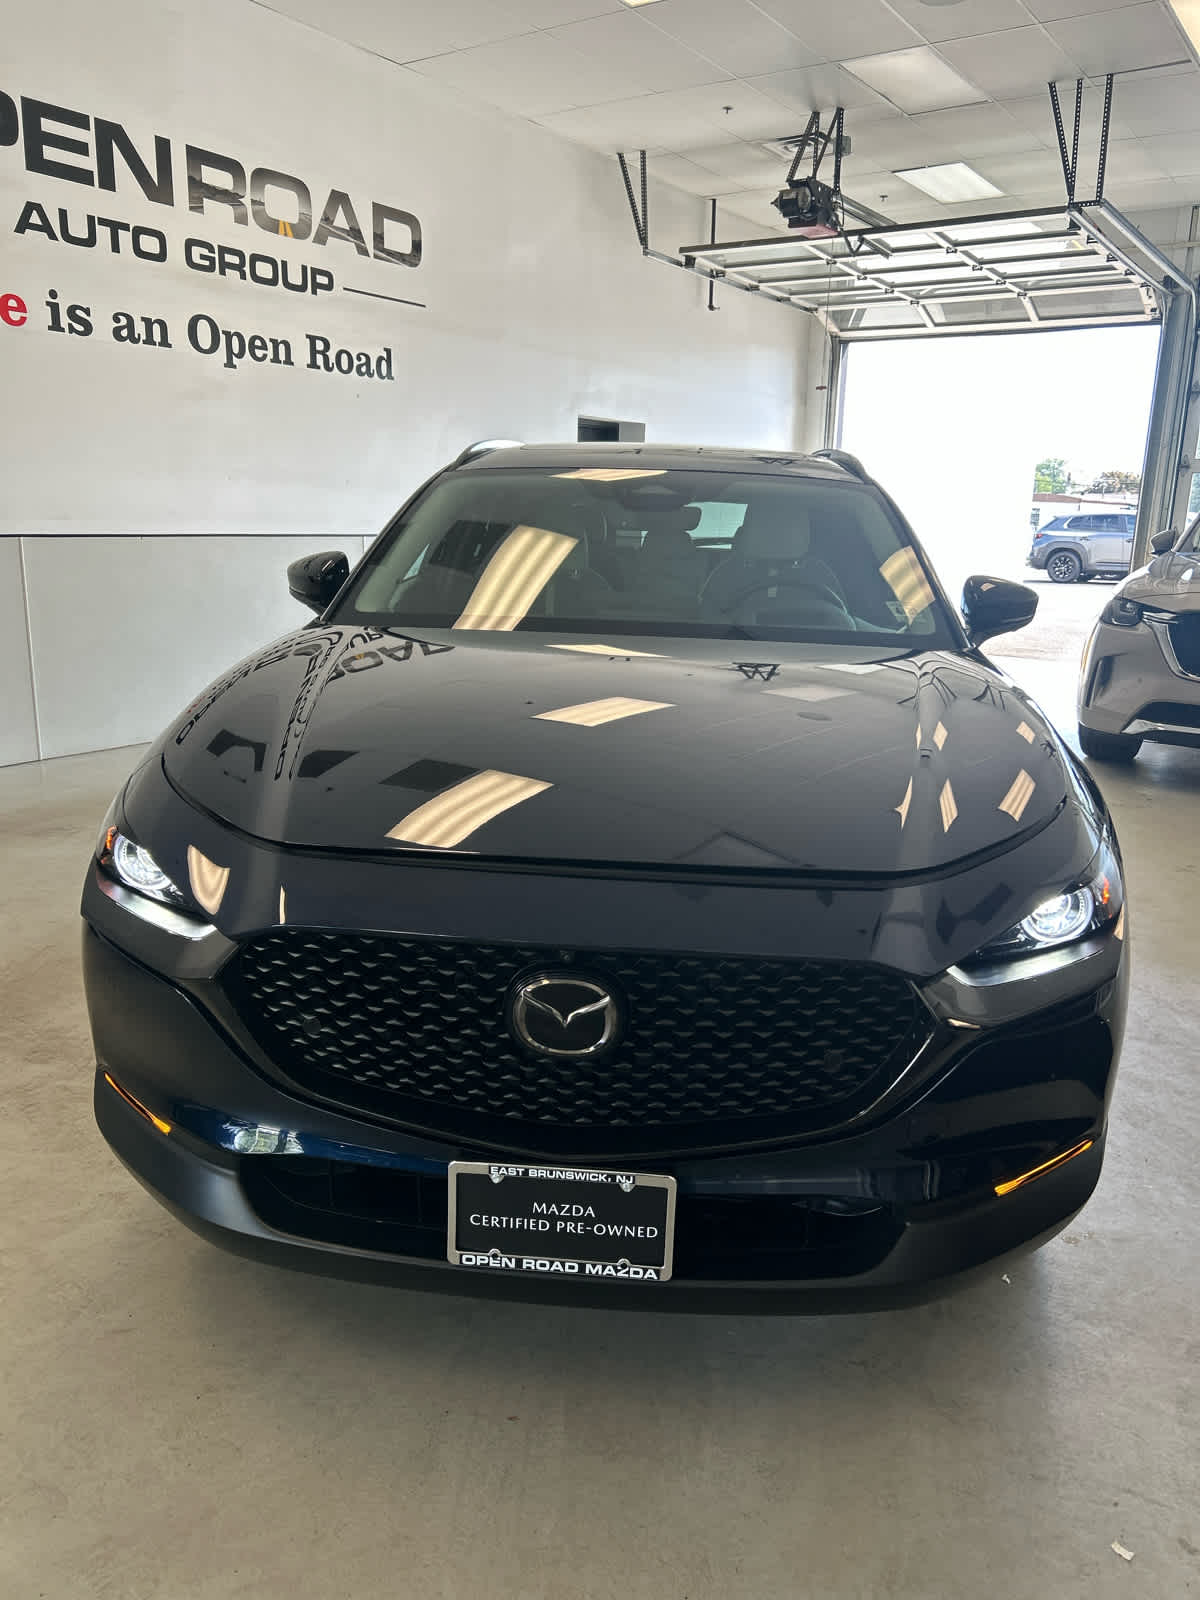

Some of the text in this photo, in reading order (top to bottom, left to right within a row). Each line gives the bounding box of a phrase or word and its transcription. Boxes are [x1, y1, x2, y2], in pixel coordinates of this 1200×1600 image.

[185, 144, 421, 268] ROAD
[13, 200, 334, 295] AUTO GROUP
[46, 288, 94, 337] is
[112, 309, 172, 349] an
[187, 314, 294, 369] Open
[305, 333, 395, 380] Road
[490, 1166, 634, 1184] EAST BRUNSWICK, NJ
[532, 1202, 595, 1217] MAZDA
[470, 1214, 658, 1238] CERTIFIED PRE-OWNED
[461, 1254, 658, 1280] OPEN ROAD MAZDA
